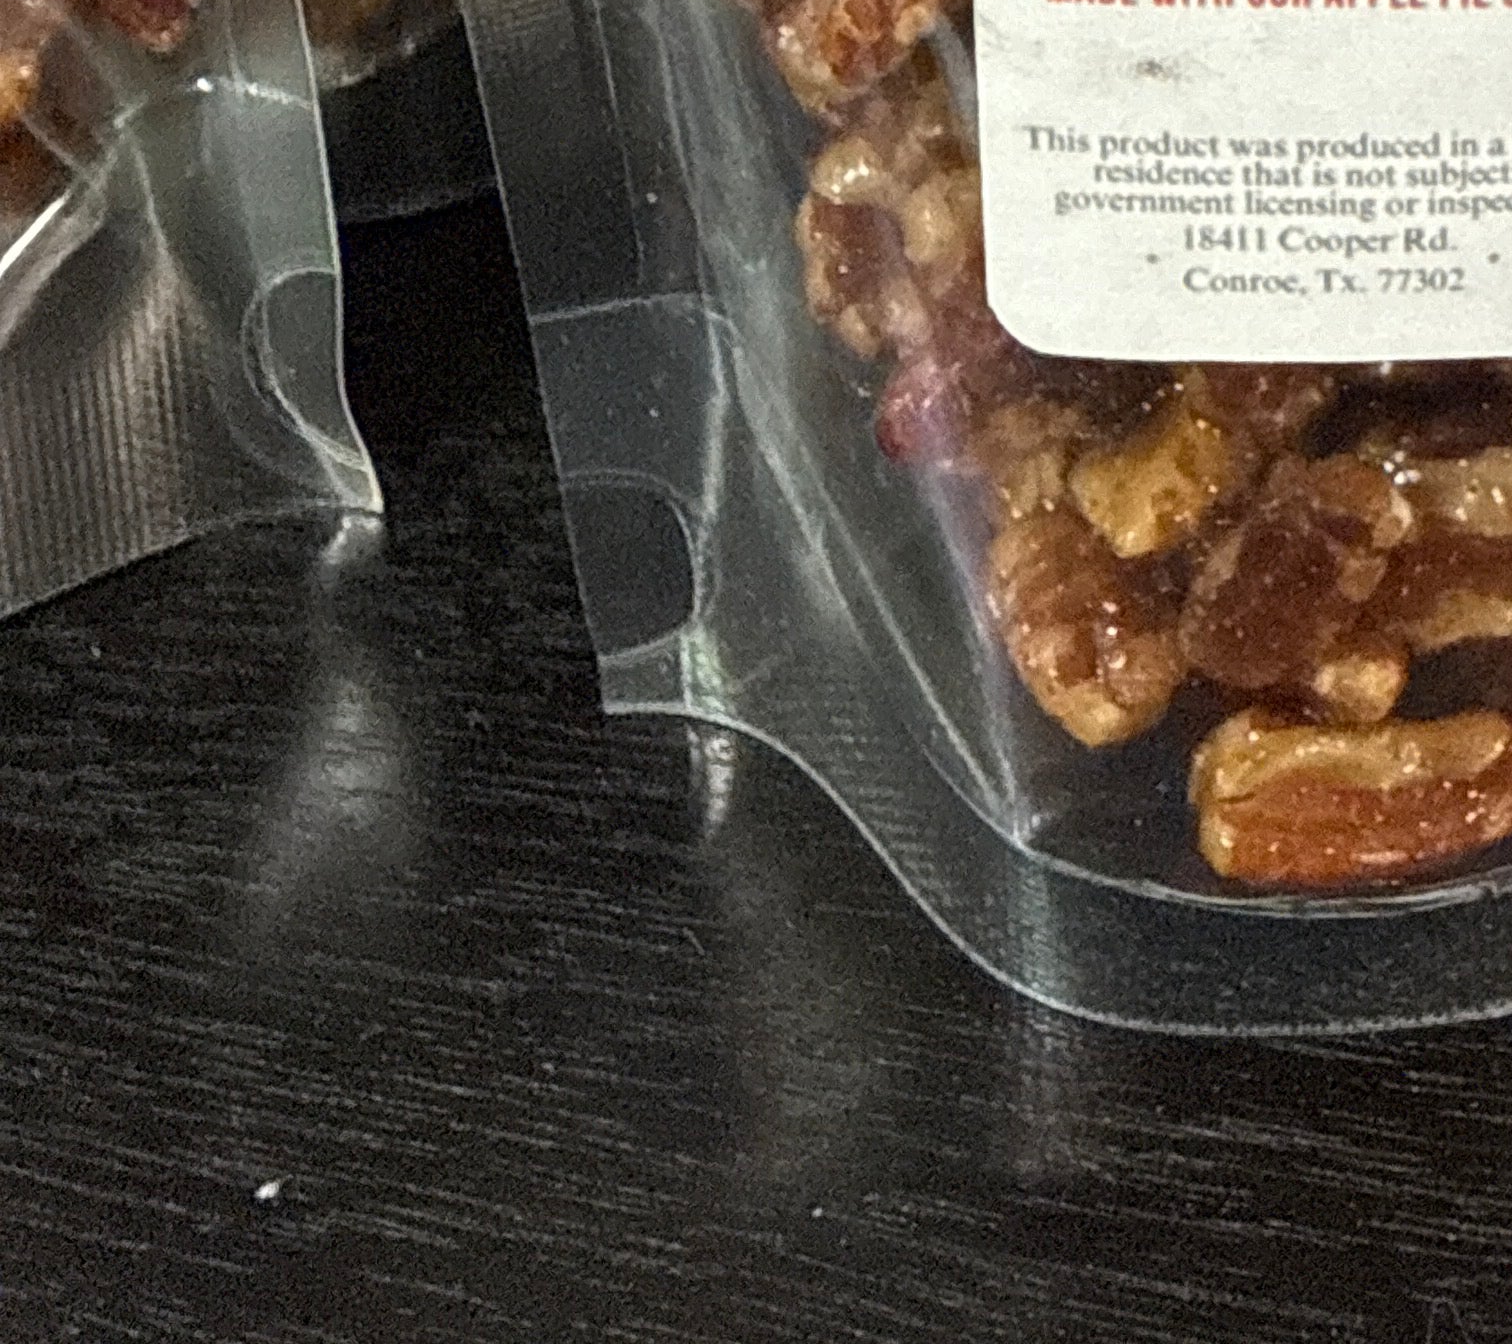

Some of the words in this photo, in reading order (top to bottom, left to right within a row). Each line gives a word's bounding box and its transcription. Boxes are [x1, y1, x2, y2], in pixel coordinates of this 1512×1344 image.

[1023, 125, 1091, 152] This
[1100, 130, 1220, 161] product
[1228, 139, 1288, 158] was
[1298, 131, 1441, 162] produced
[1451, 130, 1479, 157] in
[1487, 137, 1505, 156] a
[1094, 159, 1234, 186] residence
[1242, 162, 1303, 187] that
[1312, 161, 1337, 187] is
[1346, 165, 1397, 187] not
[1405, 160, 1511, 192] subject
[1054, 190, 1235, 216] government
[1245, 189, 1377, 223] licensing
[1384, 197, 1420, 216] or
[1183, 225, 1267, 252] 18411
[1278, 226, 1398, 259] Cooper
[1403, 226, 1458, 252] Rd.
[1377, 267, 1466, 293] 77302
